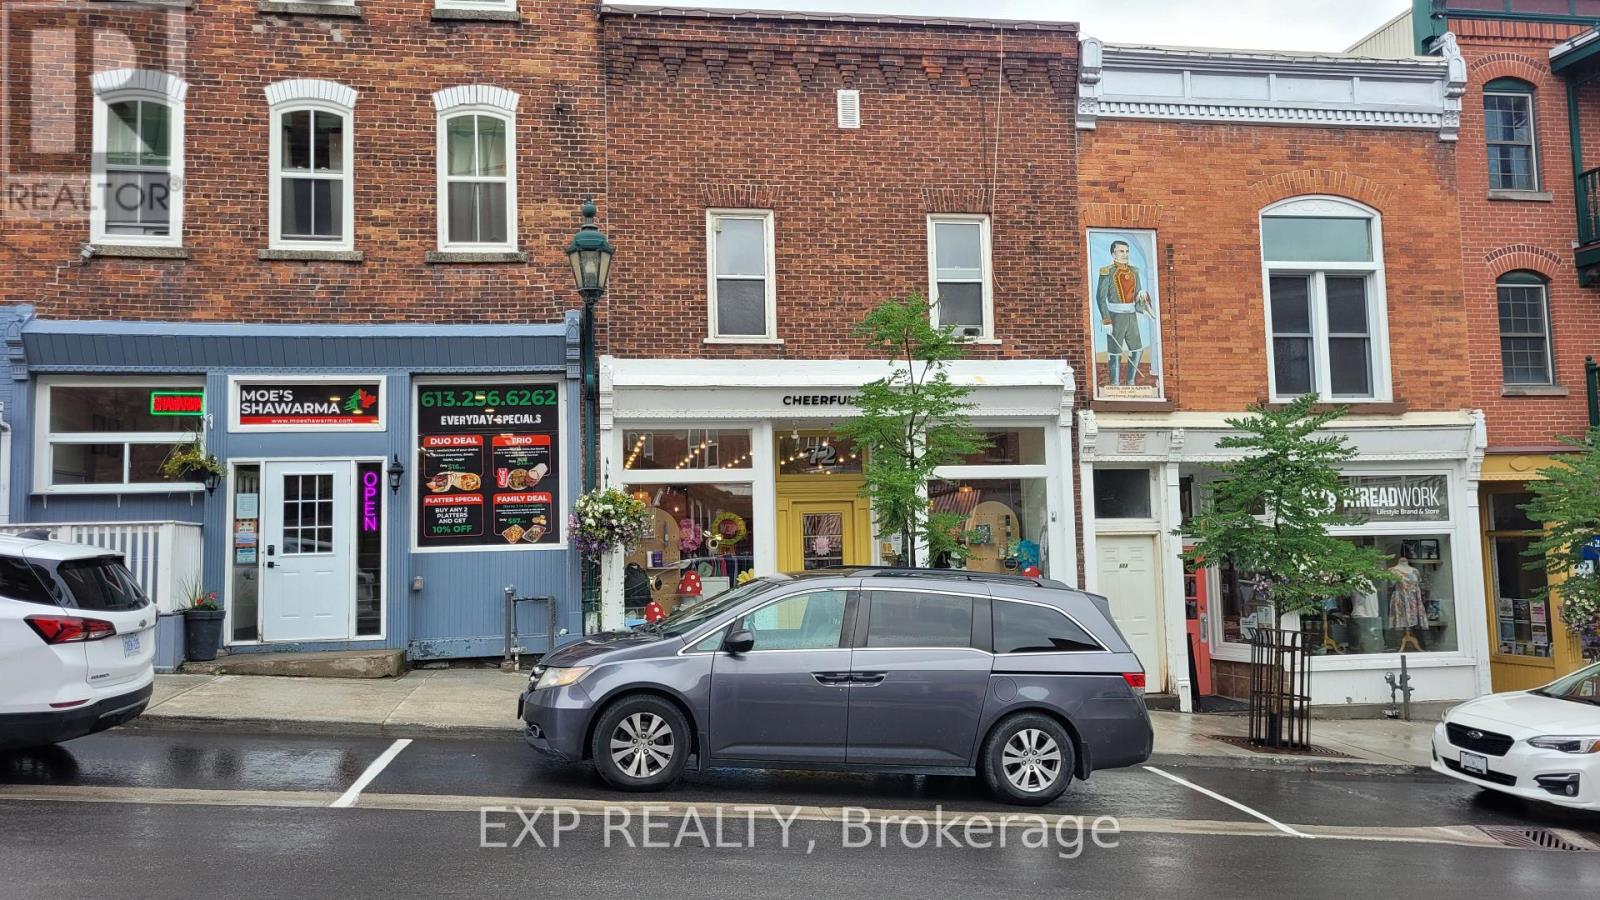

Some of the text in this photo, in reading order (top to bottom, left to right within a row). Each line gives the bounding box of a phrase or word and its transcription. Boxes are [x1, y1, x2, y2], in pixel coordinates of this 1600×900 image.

[241, 390, 293, 402] MOE'S
[421, 389, 557, 408] 613.256.6262
[241, 403, 341, 414] SHAWARMA
[440, 414, 542, 426] EVERYDAY SPECIALS
[430, 437, 452, 445] DUO
[363, 471, 378, 532] OPEN
[1376, 508, 1400, 517] Lifestyle
[432, 525, 473, 534] 10% OFF
